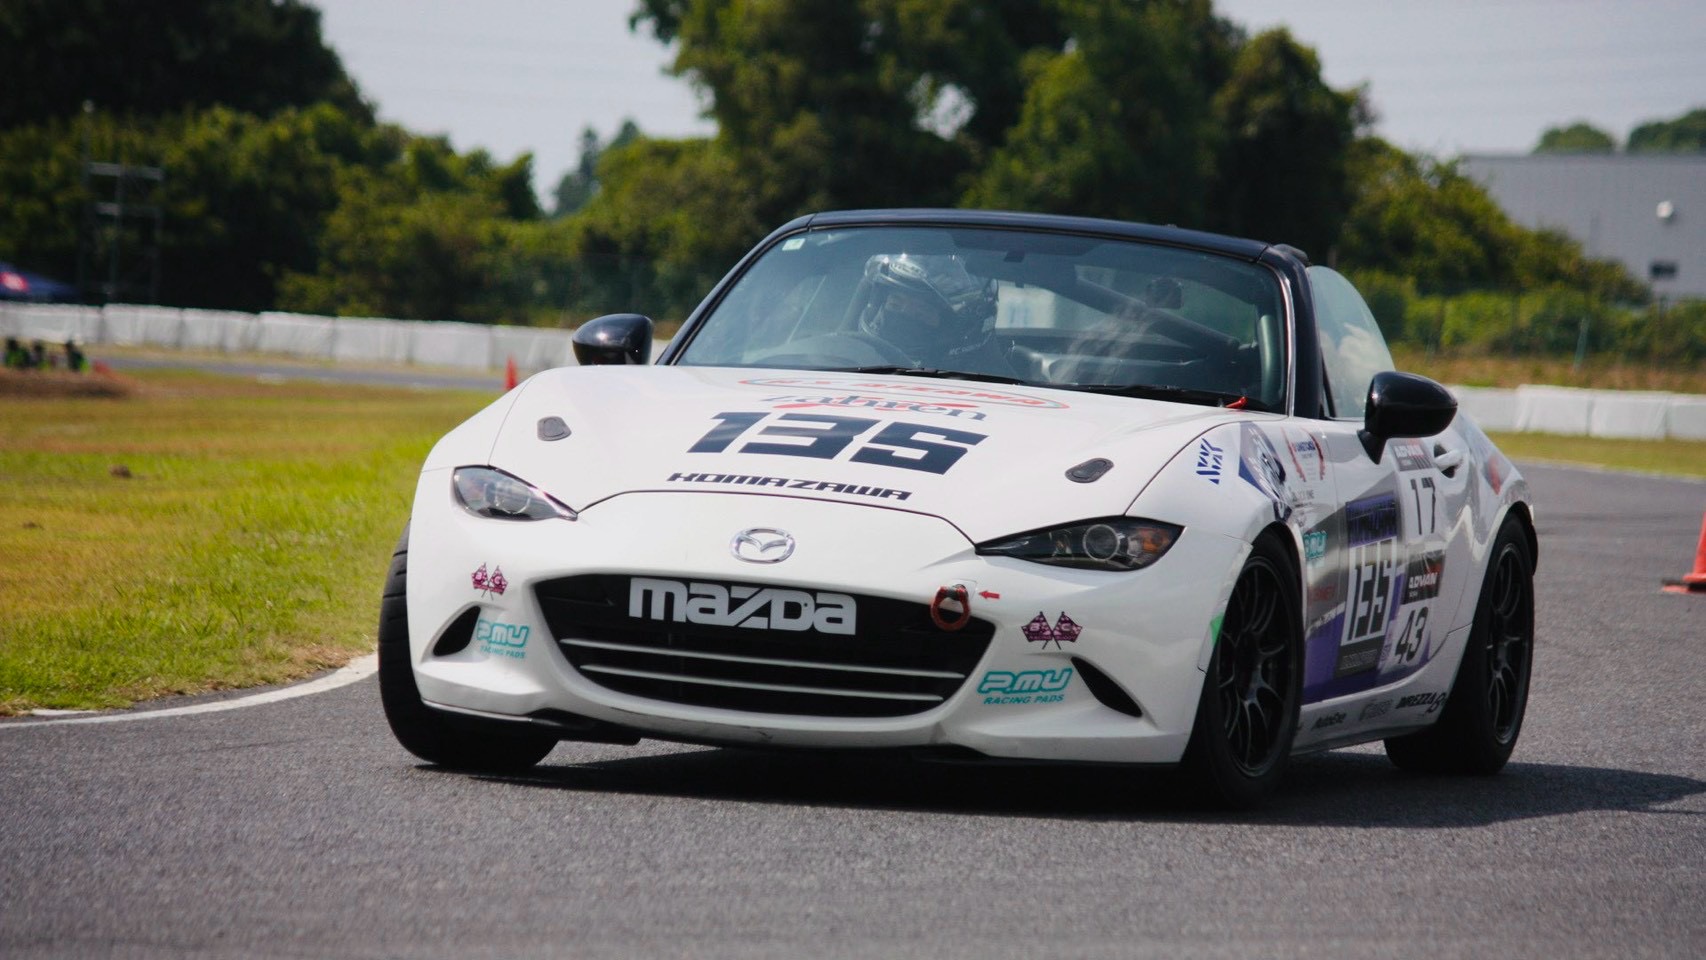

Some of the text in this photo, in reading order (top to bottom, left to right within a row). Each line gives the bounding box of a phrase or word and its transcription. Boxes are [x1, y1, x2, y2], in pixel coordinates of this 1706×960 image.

[687, 411, 989, 475] 135
[667, 472, 912, 501] KOMAZAWA
[1410, 477, 1437, 535] 17
[1408, 572, 1438, 590] ADVAN
[1395, 606, 1428, 664] 43
[983, 694, 1065, 705] RACING PADS
